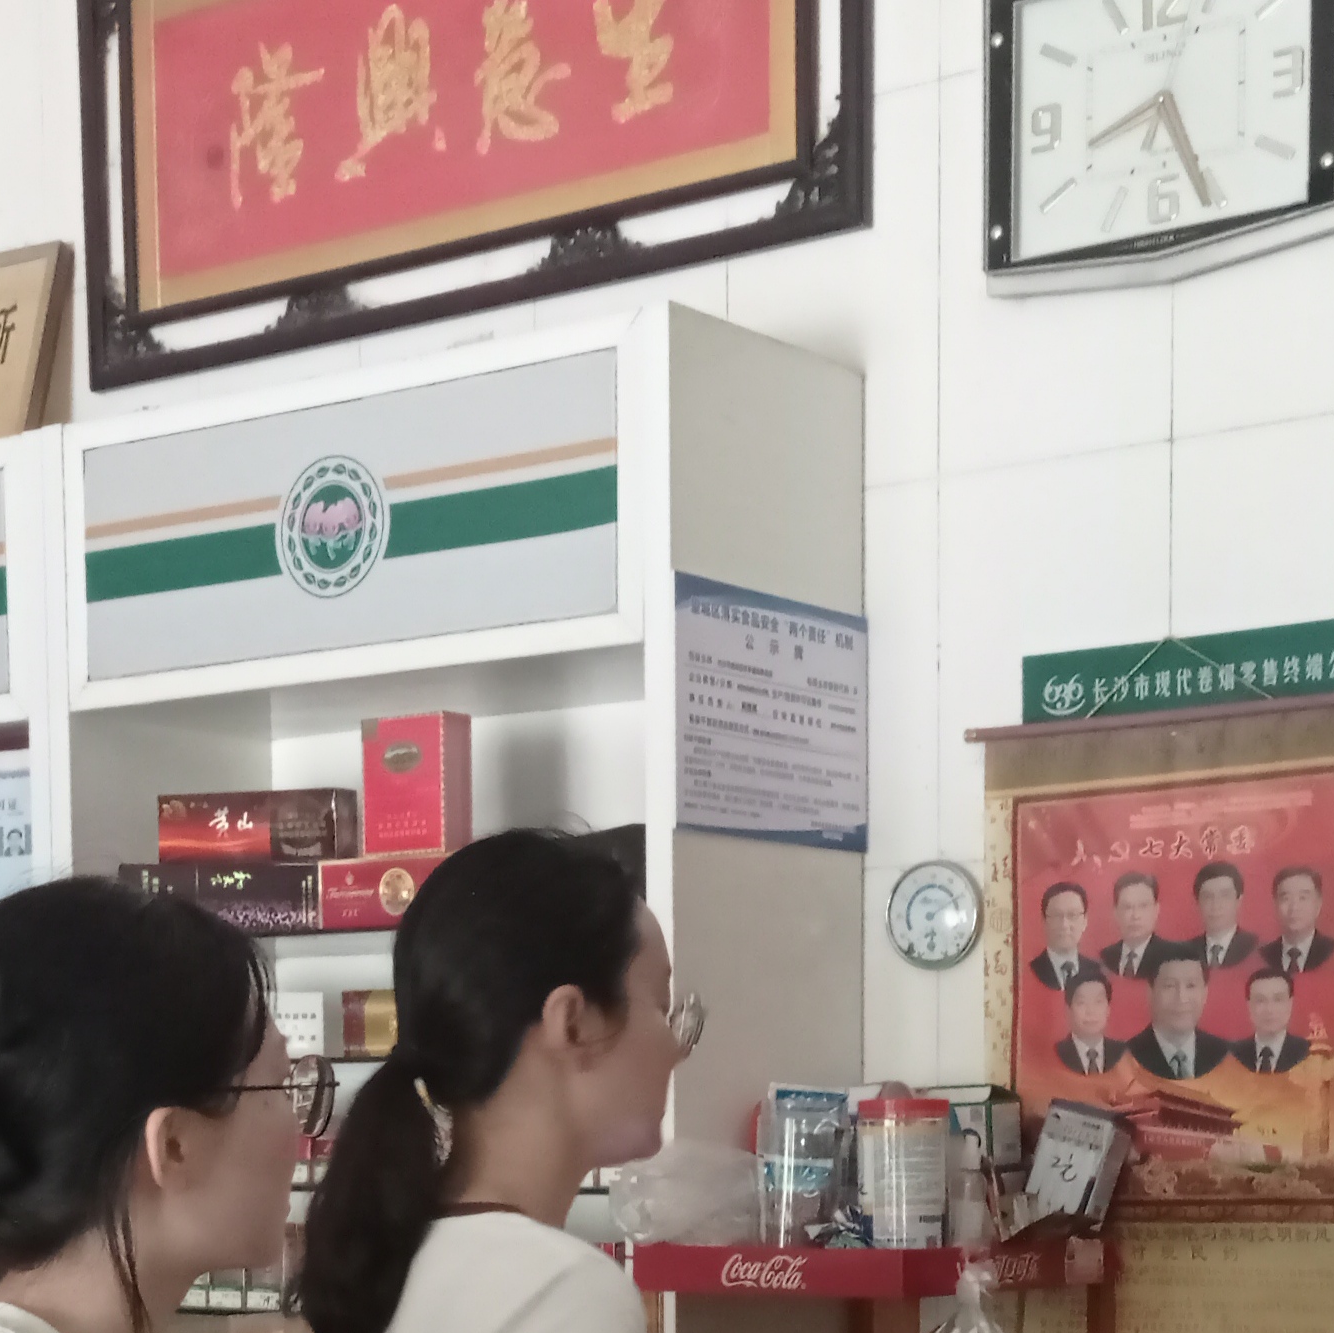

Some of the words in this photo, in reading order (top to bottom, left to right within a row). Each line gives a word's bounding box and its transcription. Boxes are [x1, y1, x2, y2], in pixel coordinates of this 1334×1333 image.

[1273, 45, 1304, 98] 3
[1031, 103, 1062, 154] 9
[1147, 174, 1179, 224] 6
[721, 1253, 808, 1291] Coca-Cola
